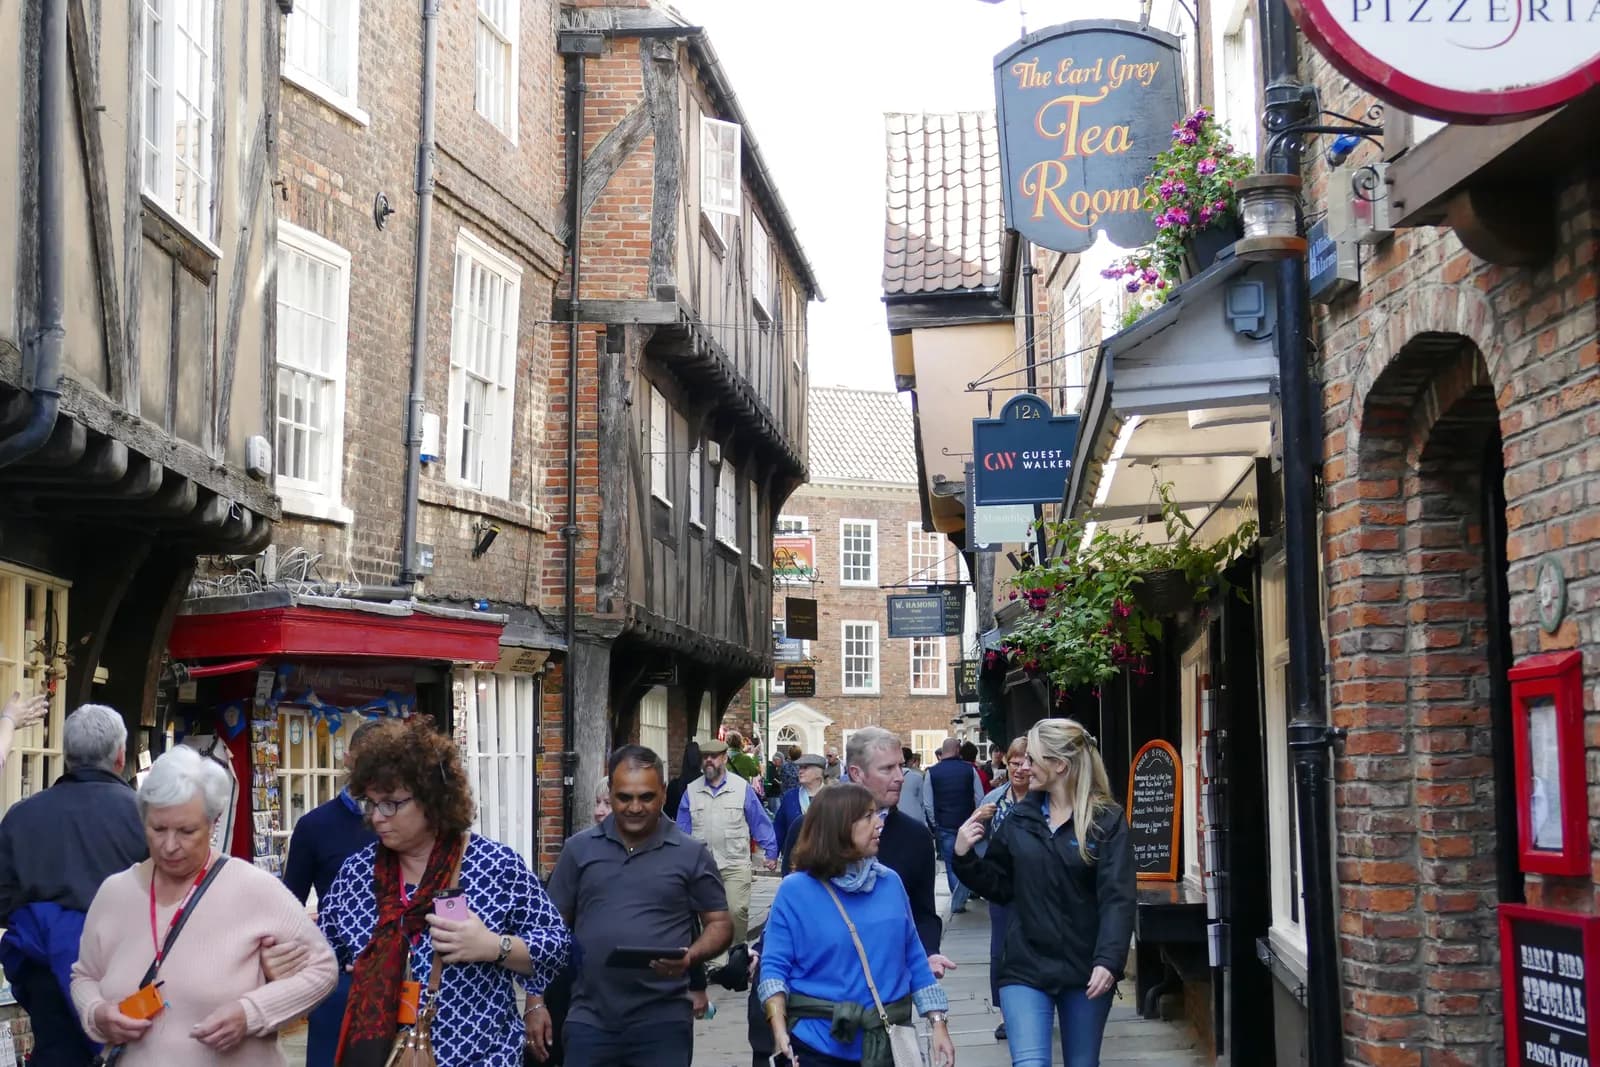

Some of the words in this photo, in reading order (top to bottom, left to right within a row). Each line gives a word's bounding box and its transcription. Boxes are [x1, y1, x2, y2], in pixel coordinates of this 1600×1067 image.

[1012, 56, 1052, 89] The
[1055, 57, 1102, 86] Earl
[1106, 54, 1160, 89] Grey
[1034, 85, 1134, 160] Tea
[1015, 405, 1041, 420] 12A
[1022, 450, 1062, 459] GUEST
[1023, 459, 1072, 469] WALKER
[895, 601, 904, 609] W.
[905, 600, 938, 609] HAMOND
[1520, 945, 1554, 974] EARLY
[1557, 952, 1584, 980] BIRD
[1522, 976, 1586, 1025] SPECIAL
[1525, 1041, 1557, 1067] PASTA
